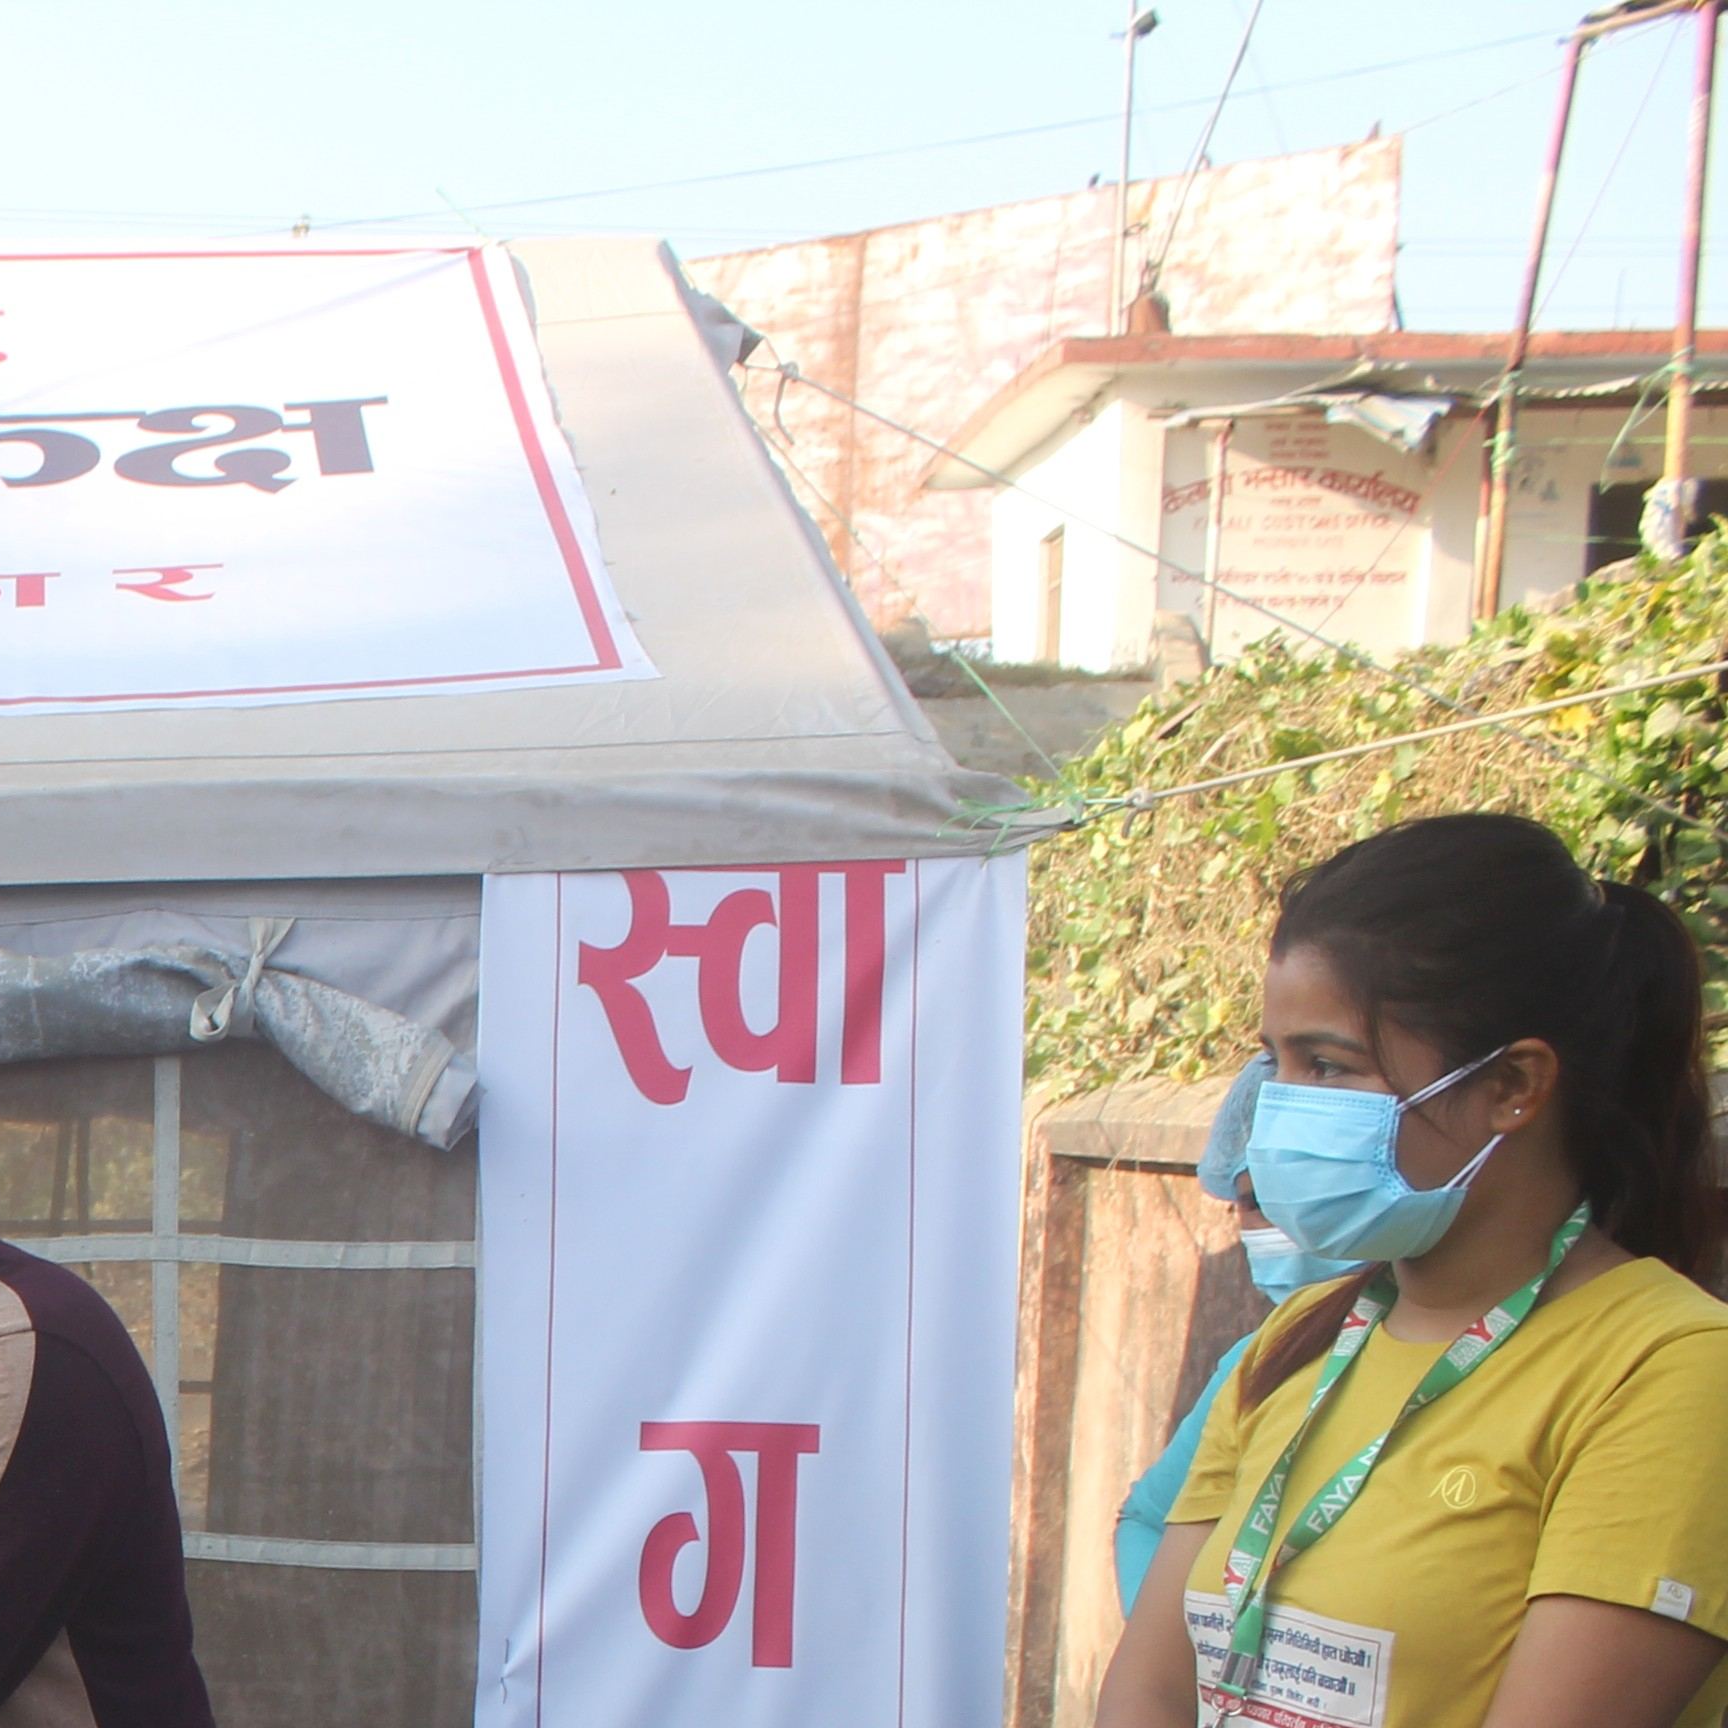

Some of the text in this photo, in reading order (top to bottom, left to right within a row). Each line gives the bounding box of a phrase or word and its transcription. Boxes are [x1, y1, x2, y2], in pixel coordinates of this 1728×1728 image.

[112, 563, 224, 602] र
[1250, 1471, 1288, 1536] FAYA
[1305, 1474, 1363, 1534] FAYA
